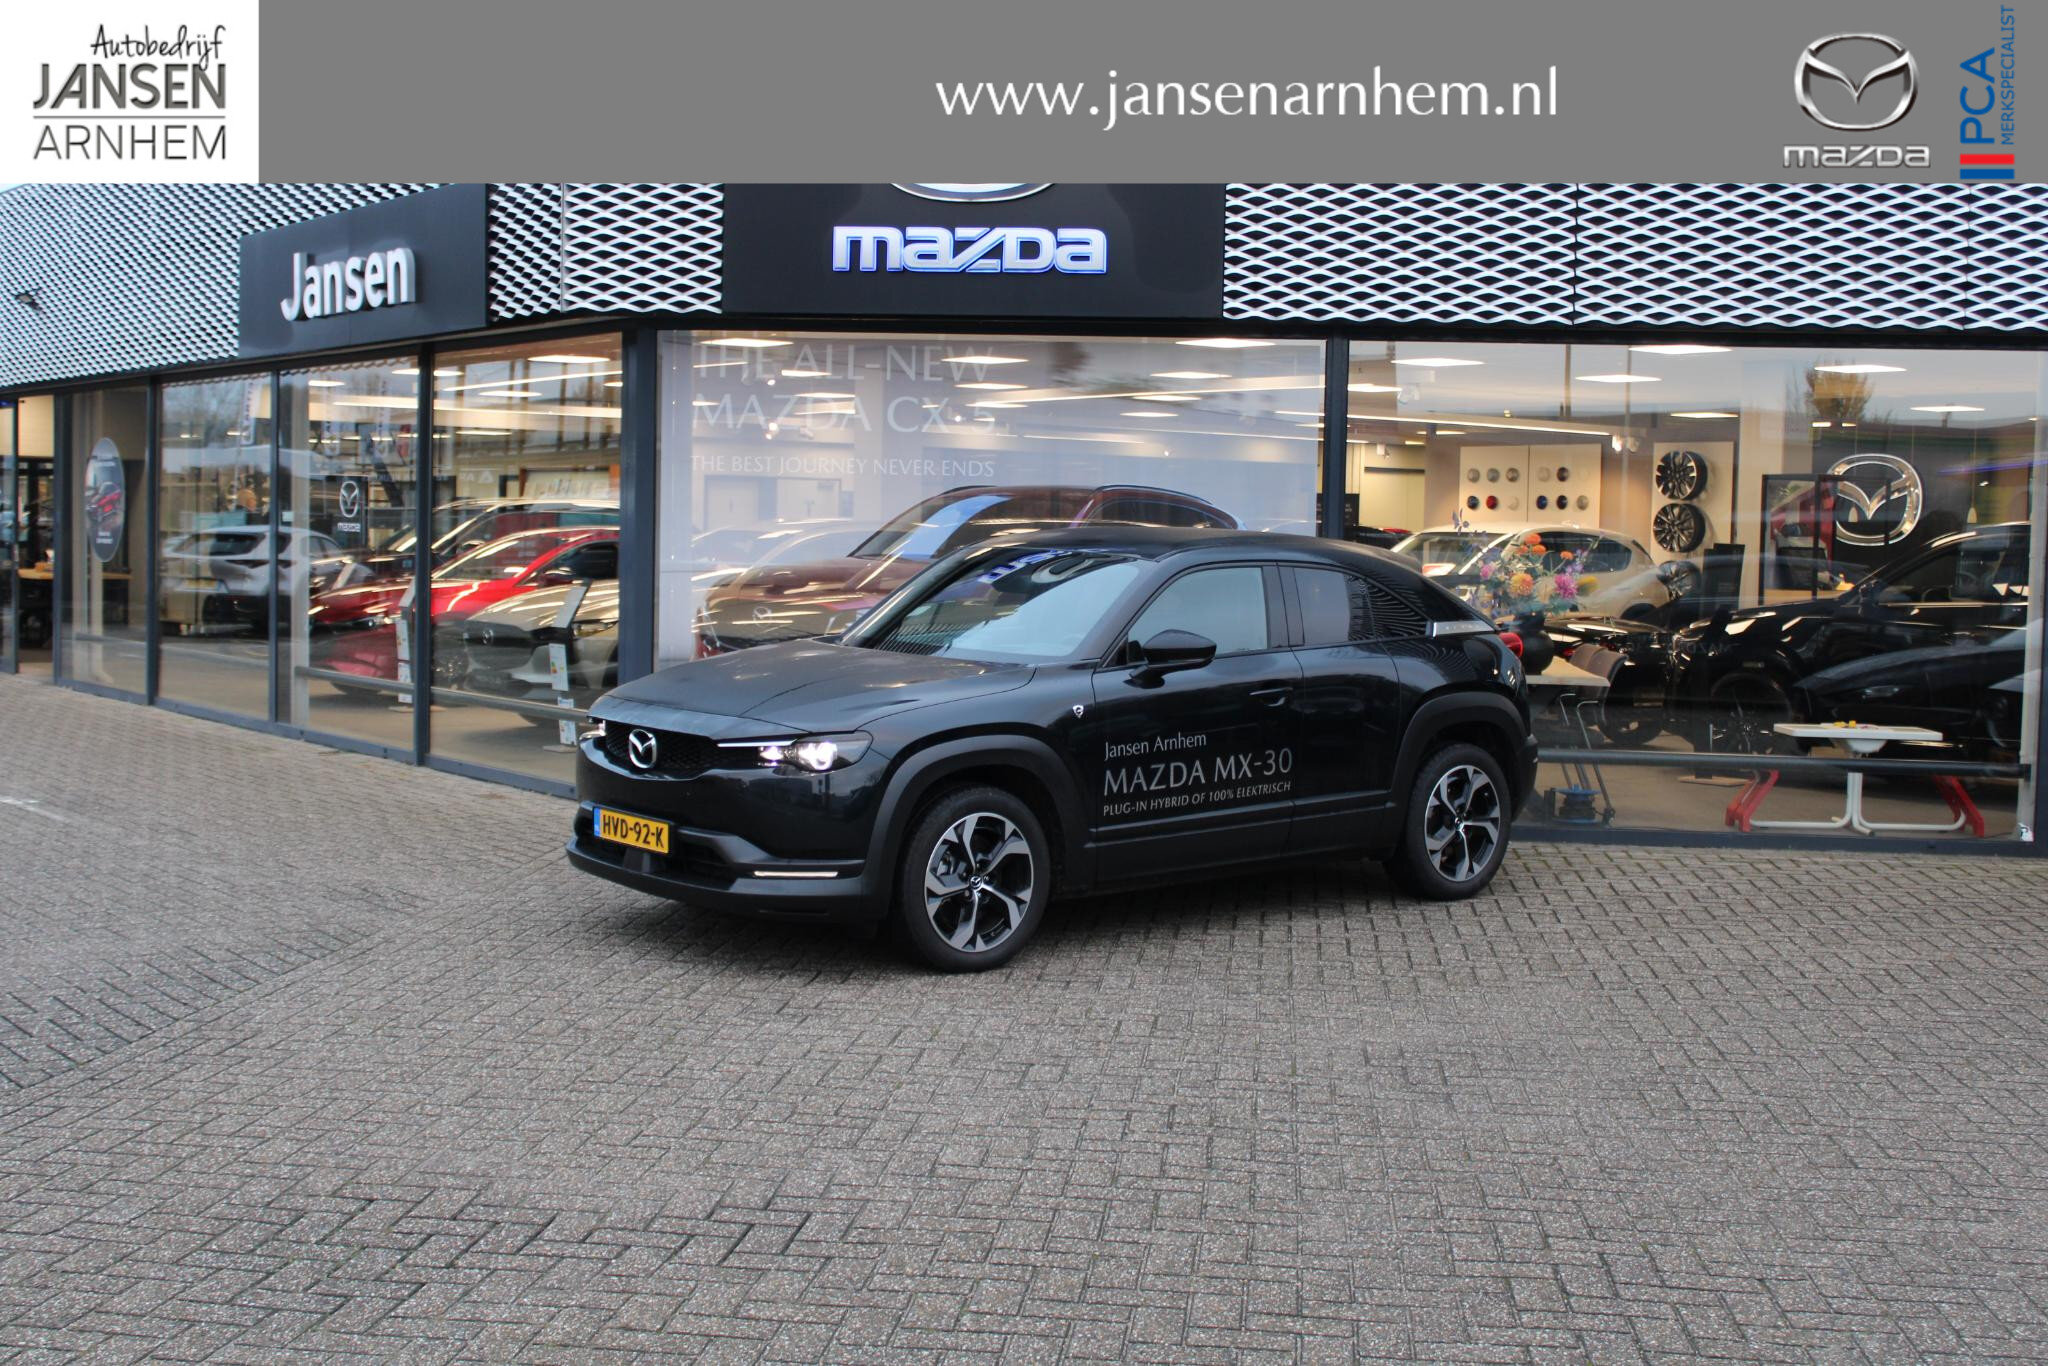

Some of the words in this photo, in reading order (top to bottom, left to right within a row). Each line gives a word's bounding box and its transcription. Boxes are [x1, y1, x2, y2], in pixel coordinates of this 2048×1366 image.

[280, 246, 416, 323] Jansen
[696, 342, 776, 380] THE
[793, 343, 996, 383] ALL-NEW
[692, 393, 873, 433] MAZDA
[691, 455, 725, 473] THE
[732, 456, 772, 474] BEST
[776, 456, 869, 476] JOURNEY
[874, 458, 937, 476] NEVER
[942, 460, 995, 478] ENDS
[1104, 741, 1149, 761] Jansen
[1153, 732, 1207, 753] Arnhem
[1103, 760, 1206, 797] MAZDA
[1214, 747, 1293, 783] MX-30
[1103, 802, 1147, 817] PLUG-IN
[1150, 795, 1190, 811] HYBRID
[1191, 792, 1207, 806] OF
[1209, 788, 1235, 803] 100%
[1236, 780, 1292, 799] ELEKTRISCH
[602, 814, 665, 849] HVD-92-K
